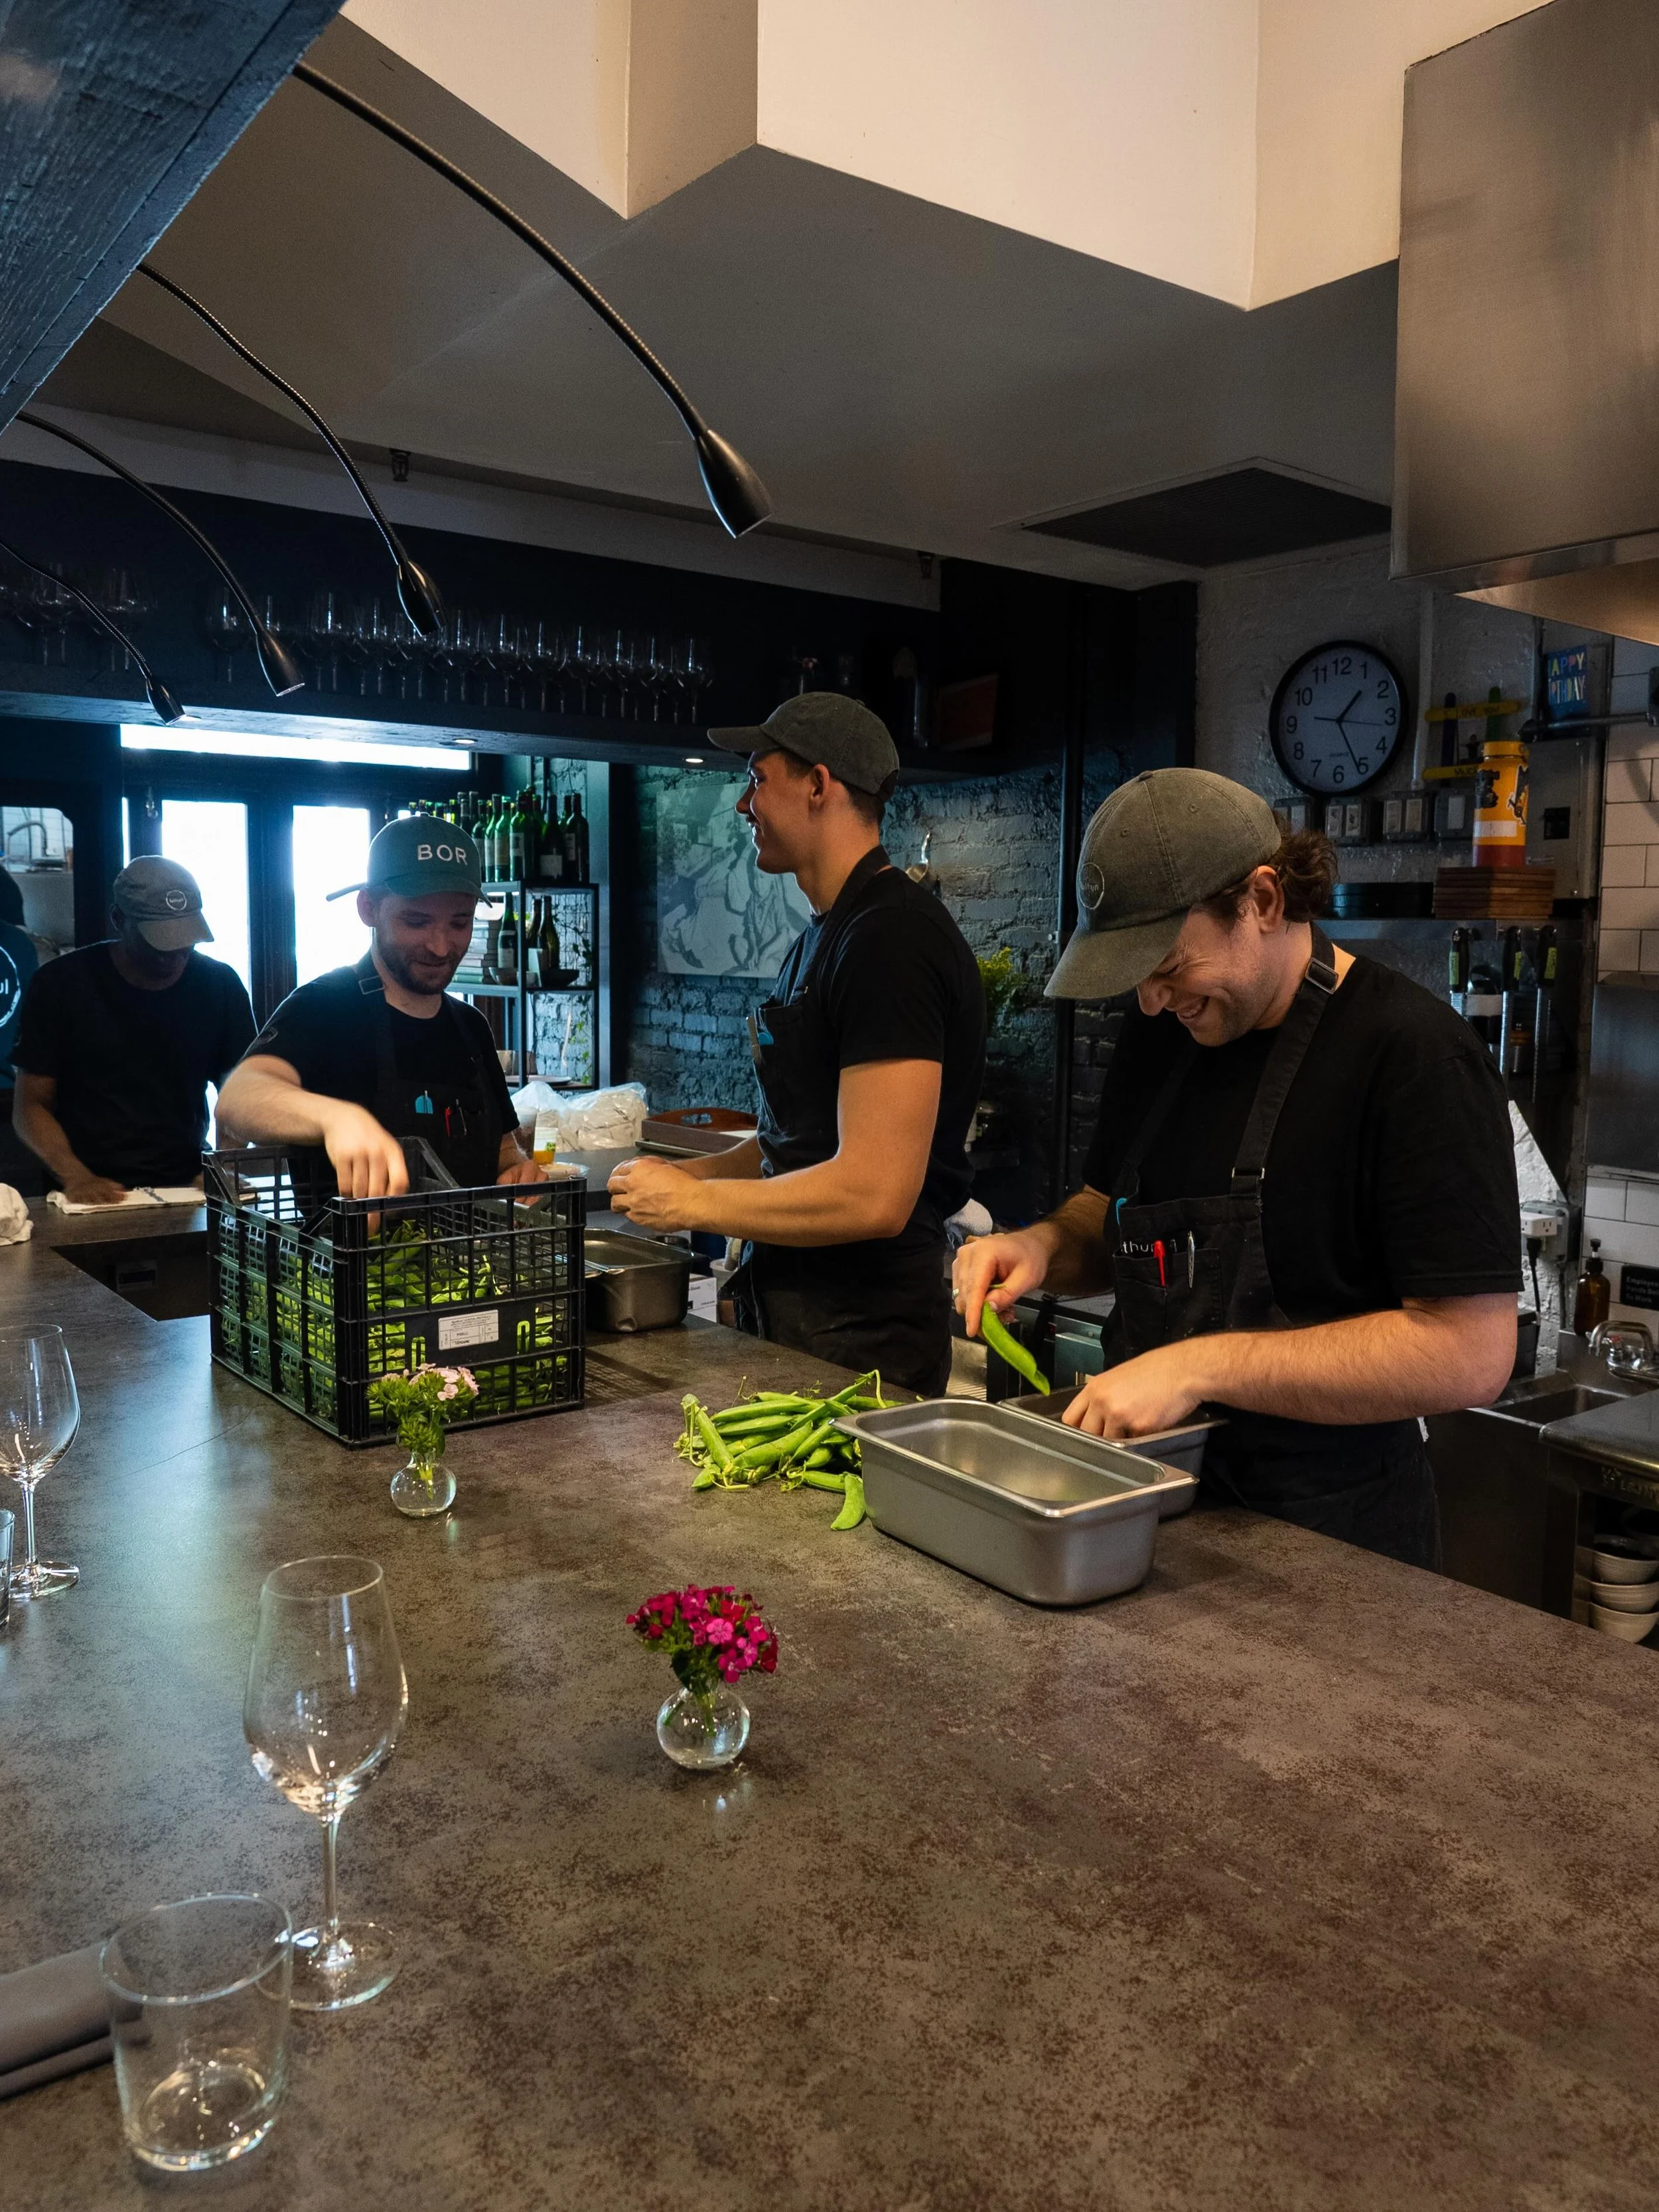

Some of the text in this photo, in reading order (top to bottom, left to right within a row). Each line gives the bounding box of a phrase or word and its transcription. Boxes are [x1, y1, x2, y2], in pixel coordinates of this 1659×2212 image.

[1313, 666, 1327, 684] 11
[1332, 656, 1352, 676] 12
[1360, 661, 1368, 679] 1
[1295, 687, 1313, 706] 10
[1377, 680, 1390, 699] 2
[1286, 715, 1298, 734] 9
[1384, 707, 1397, 726] 3
[1293, 742, 1304, 760] 8
[1376, 735, 1388, 755] 4
[1311, 759, 1323, 777] 7
[1333, 765, 1344, 784] 6
[1357, 757, 1369, 774] 5
[417, 844, 468, 865] BOR
